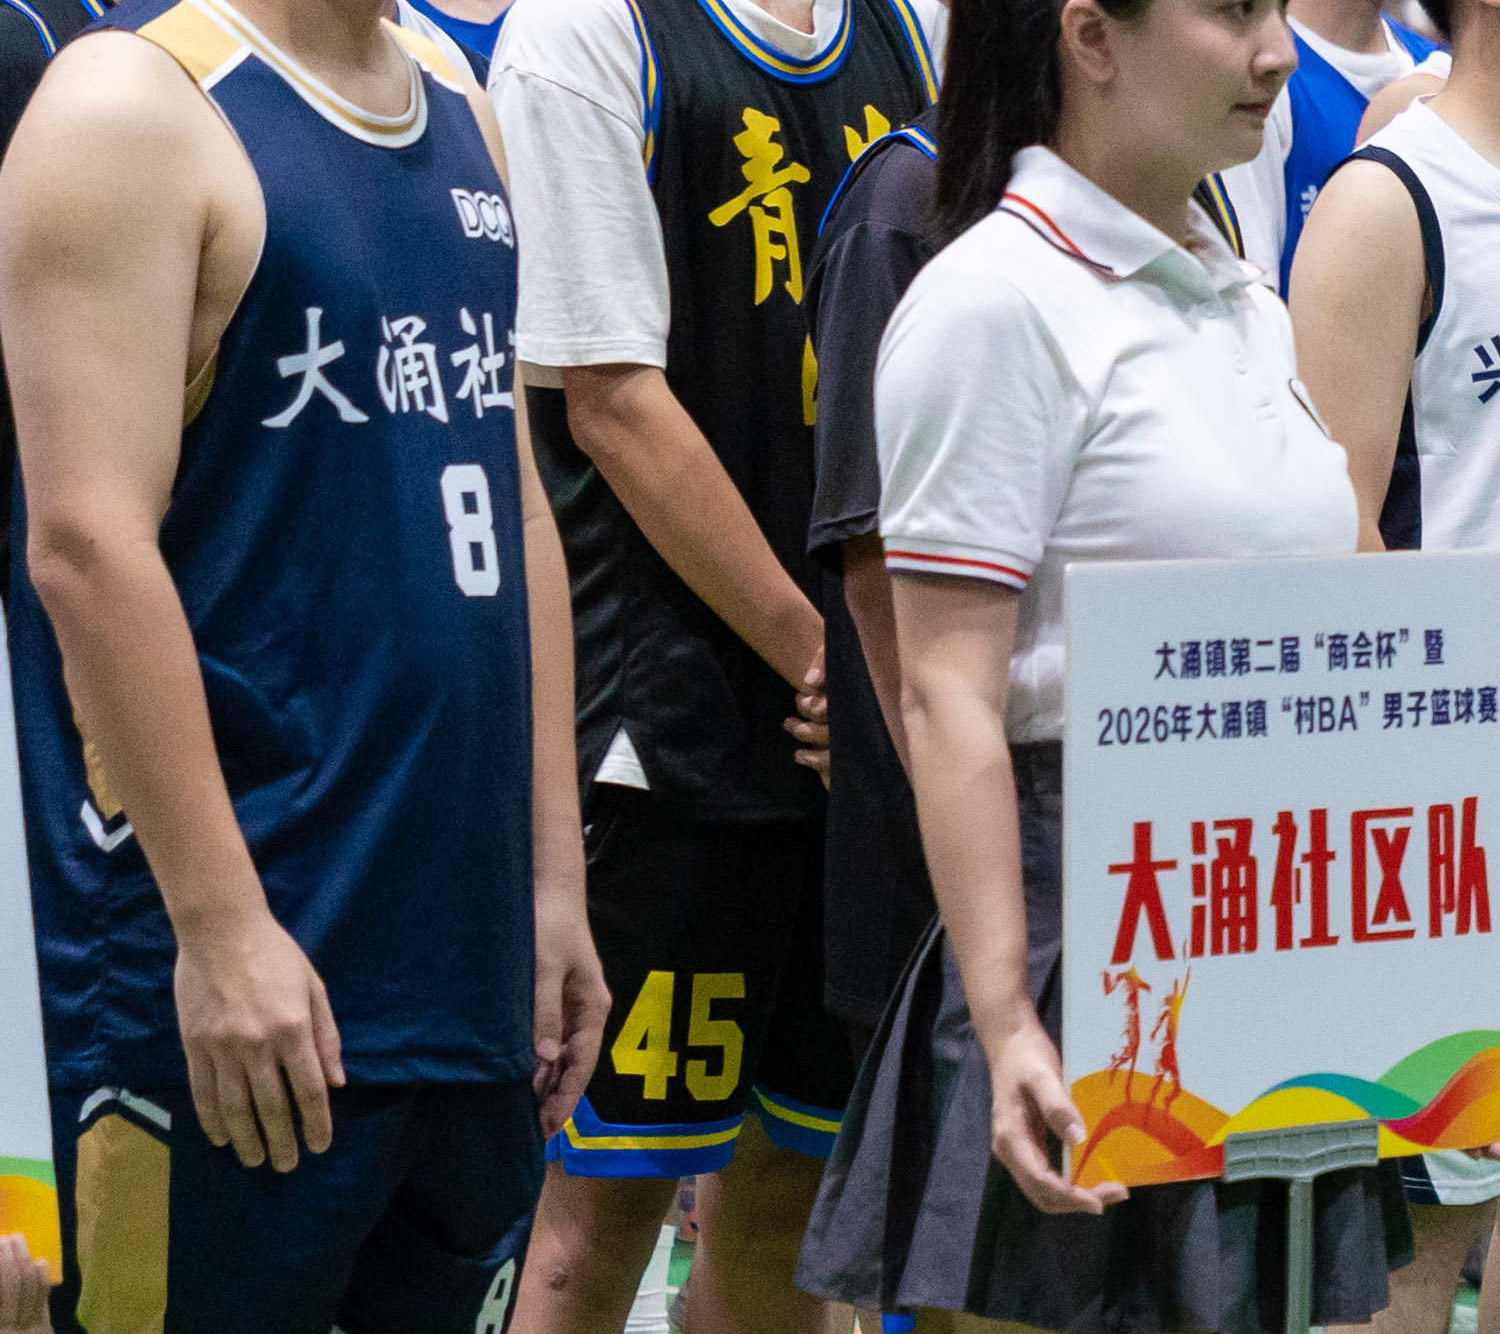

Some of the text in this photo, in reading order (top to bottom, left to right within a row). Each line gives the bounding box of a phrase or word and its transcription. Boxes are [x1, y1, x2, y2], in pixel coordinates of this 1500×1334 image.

[708, 105, 891, 306] 青
[261, 306, 518, 429] 大涌社
[440, 463, 501, 597] 8
[1107, 796, 1492, 967] 大涌社区队
[610, 970, 746, 1101] 45
